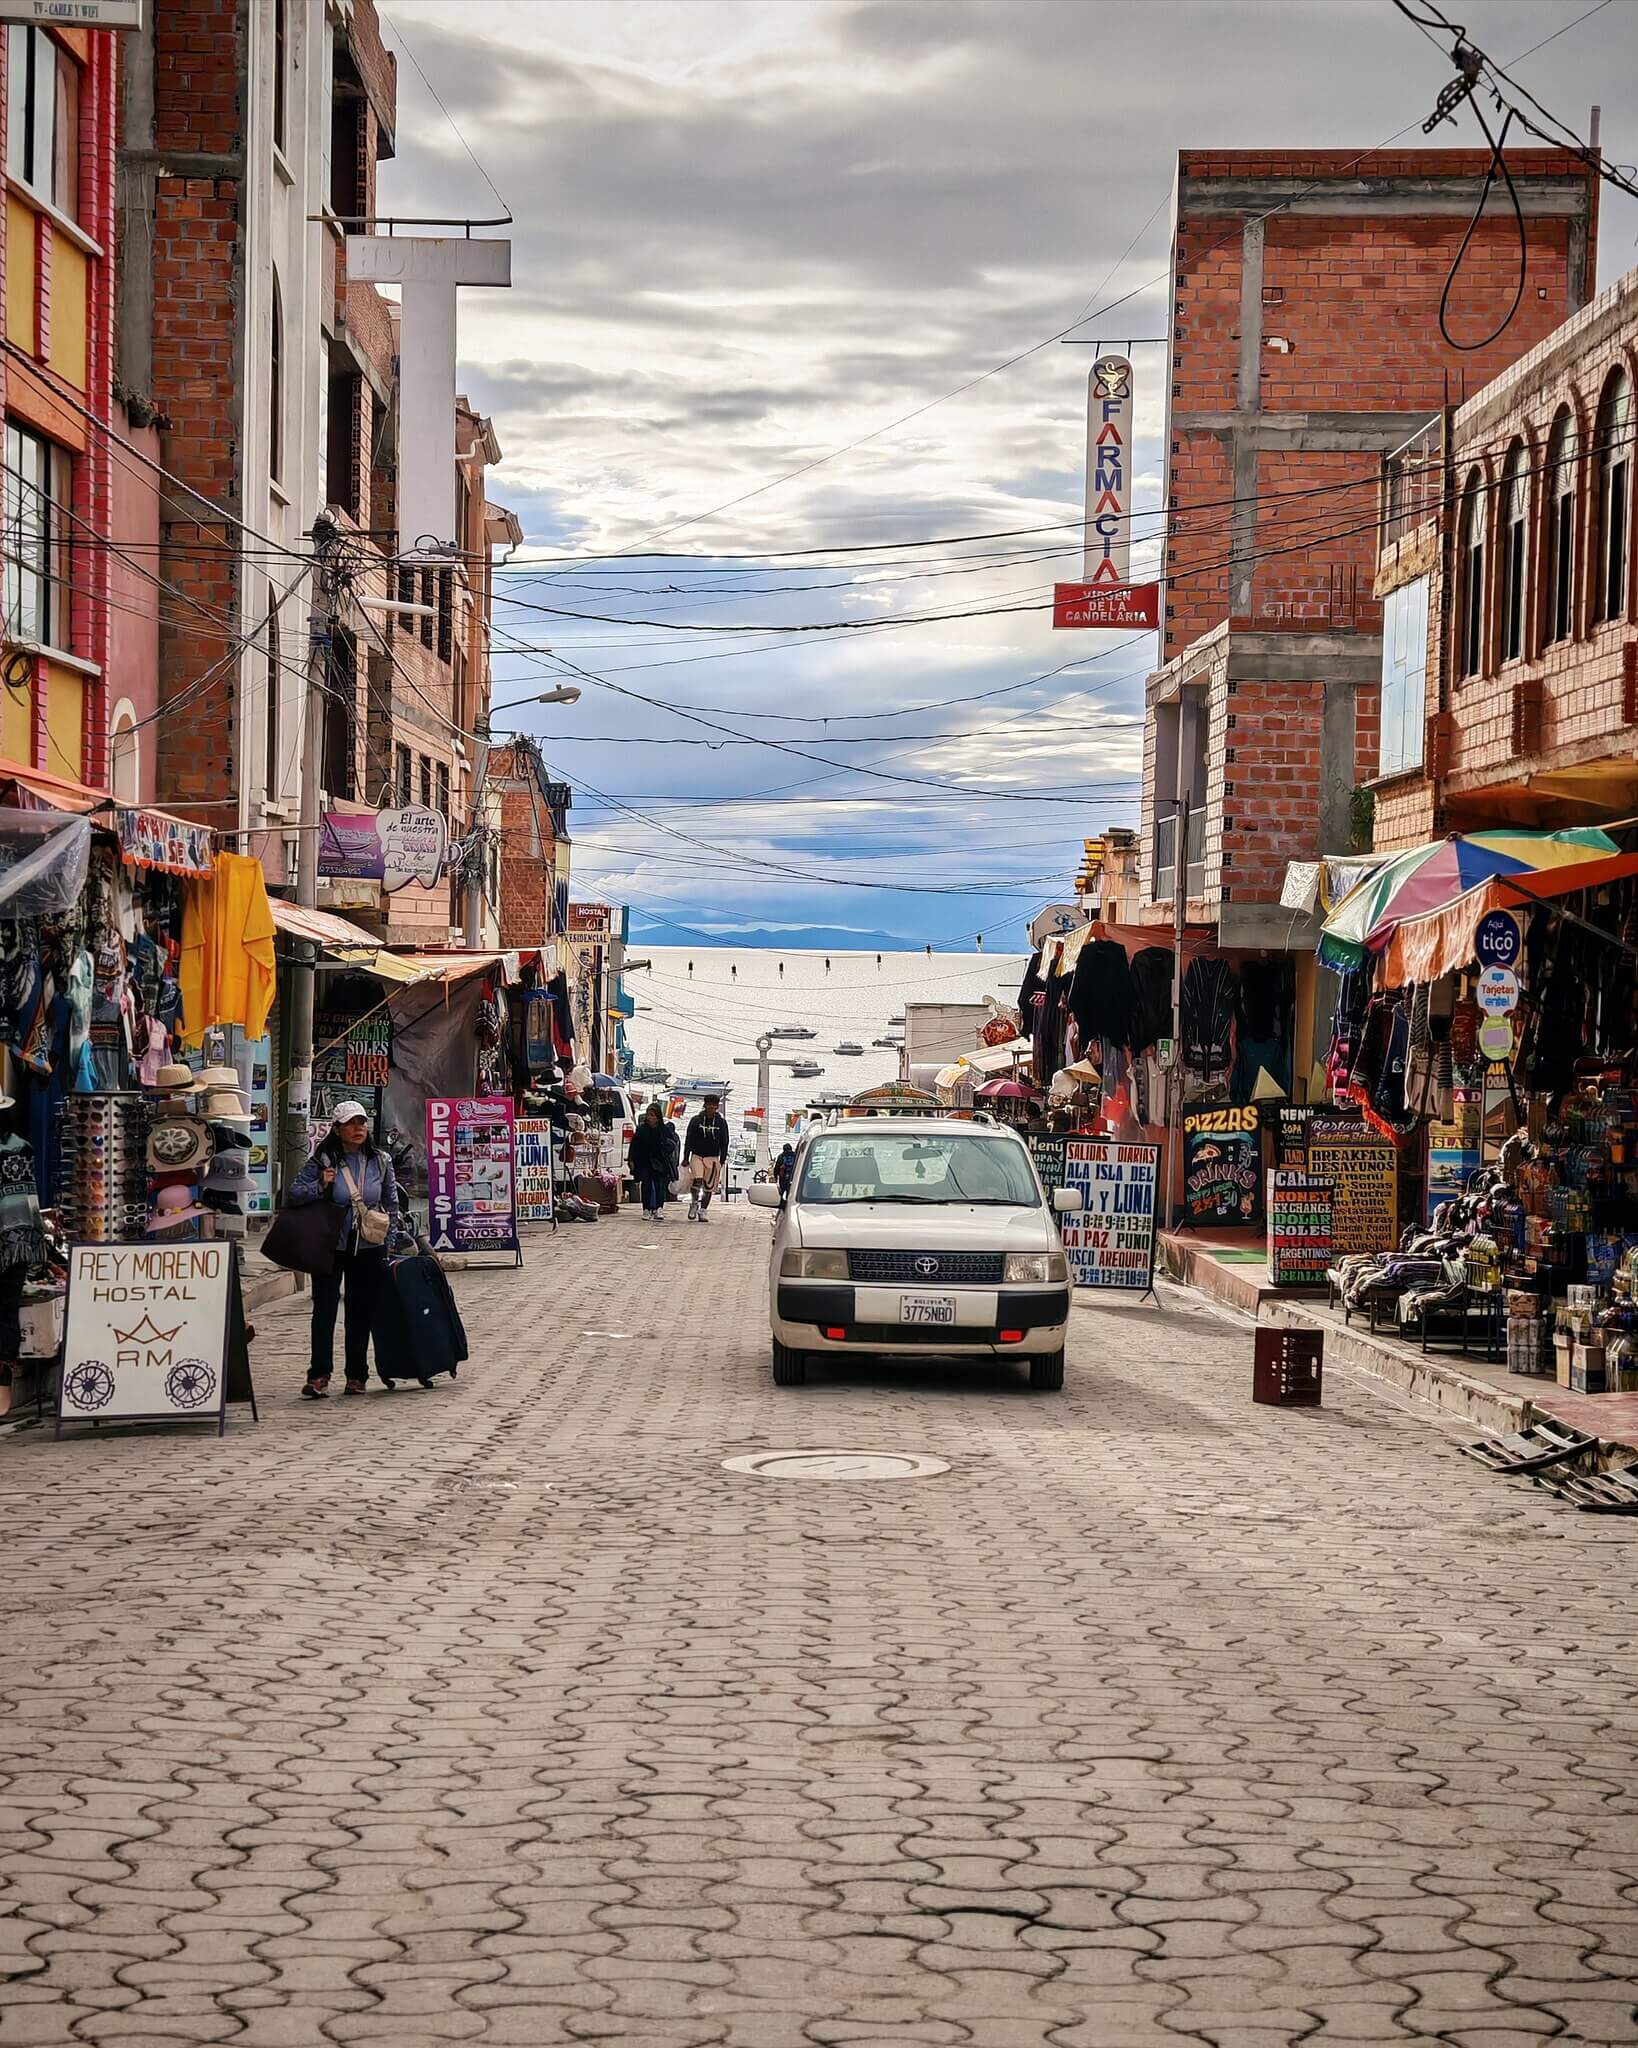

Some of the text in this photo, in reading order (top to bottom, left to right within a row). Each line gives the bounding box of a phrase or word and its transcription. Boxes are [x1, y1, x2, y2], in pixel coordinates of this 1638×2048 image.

[1092, 400, 1123, 582] FARMACIA
[1089, 601, 1126, 611] DE LA
[1065, 611, 1147, 622] CANDELARIA
[400, 813, 435, 826] El arte
[578, 907, 606, 917] HOSTAL
[1481, 984, 1514, 997] Tarjetas
[347, 1040, 389, 1056] SOLES
[347, 1055, 388, 1072] EURO
[346, 1071, 389, 1087] REALES
[1281, 1123, 1303, 1134] SOPA
[526, 1133, 539, 1146] DEL
[1429, 1138, 1473, 1149] ISLAS
[521, 1146, 549, 1166] LUNA
[1068, 1143, 1155, 1164] SALIDAS DIARIAS
[1312, 1150, 1394, 1161] BREAKFAST
[1096, 1164, 1122, 1181] ISLA
[1130, 1165, 1153, 1182] DEL
[1312, 1161, 1395, 1173] DESAYUNOS
[431, 1102, 455, 1249] DENTISTA
[523, 1178, 550, 1191] PUNO
[831, 1184, 875, 1198] TAXI
[1100, 1190, 1109, 1213] Y
[1113, 1183, 1151, 1215] LUNA
[1275, 1191, 1330, 1202] MONEY
[1274, 1203, 1331, 1214] EXCHANGE
[1063, 1213, 1080, 1228] Hrs
[1274, 1214, 1331, 1225] DOLAR
[457, 1229, 511, 1239] RAYOS X
[1275, 1225, 1331, 1236] SOLES
[1063, 1228, 1150, 1250] LA PAZ PUNO
[1066, 1248, 1148, 1269] USCO AREQUIPA
[1280, 1248, 1332, 1259] ARGENTINOS
[79, 1250, 220, 1281] REY MORENO
[1280, 1270, 1327, 1281] REALE
[93, 1286, 197, 1303] HOSTAL
